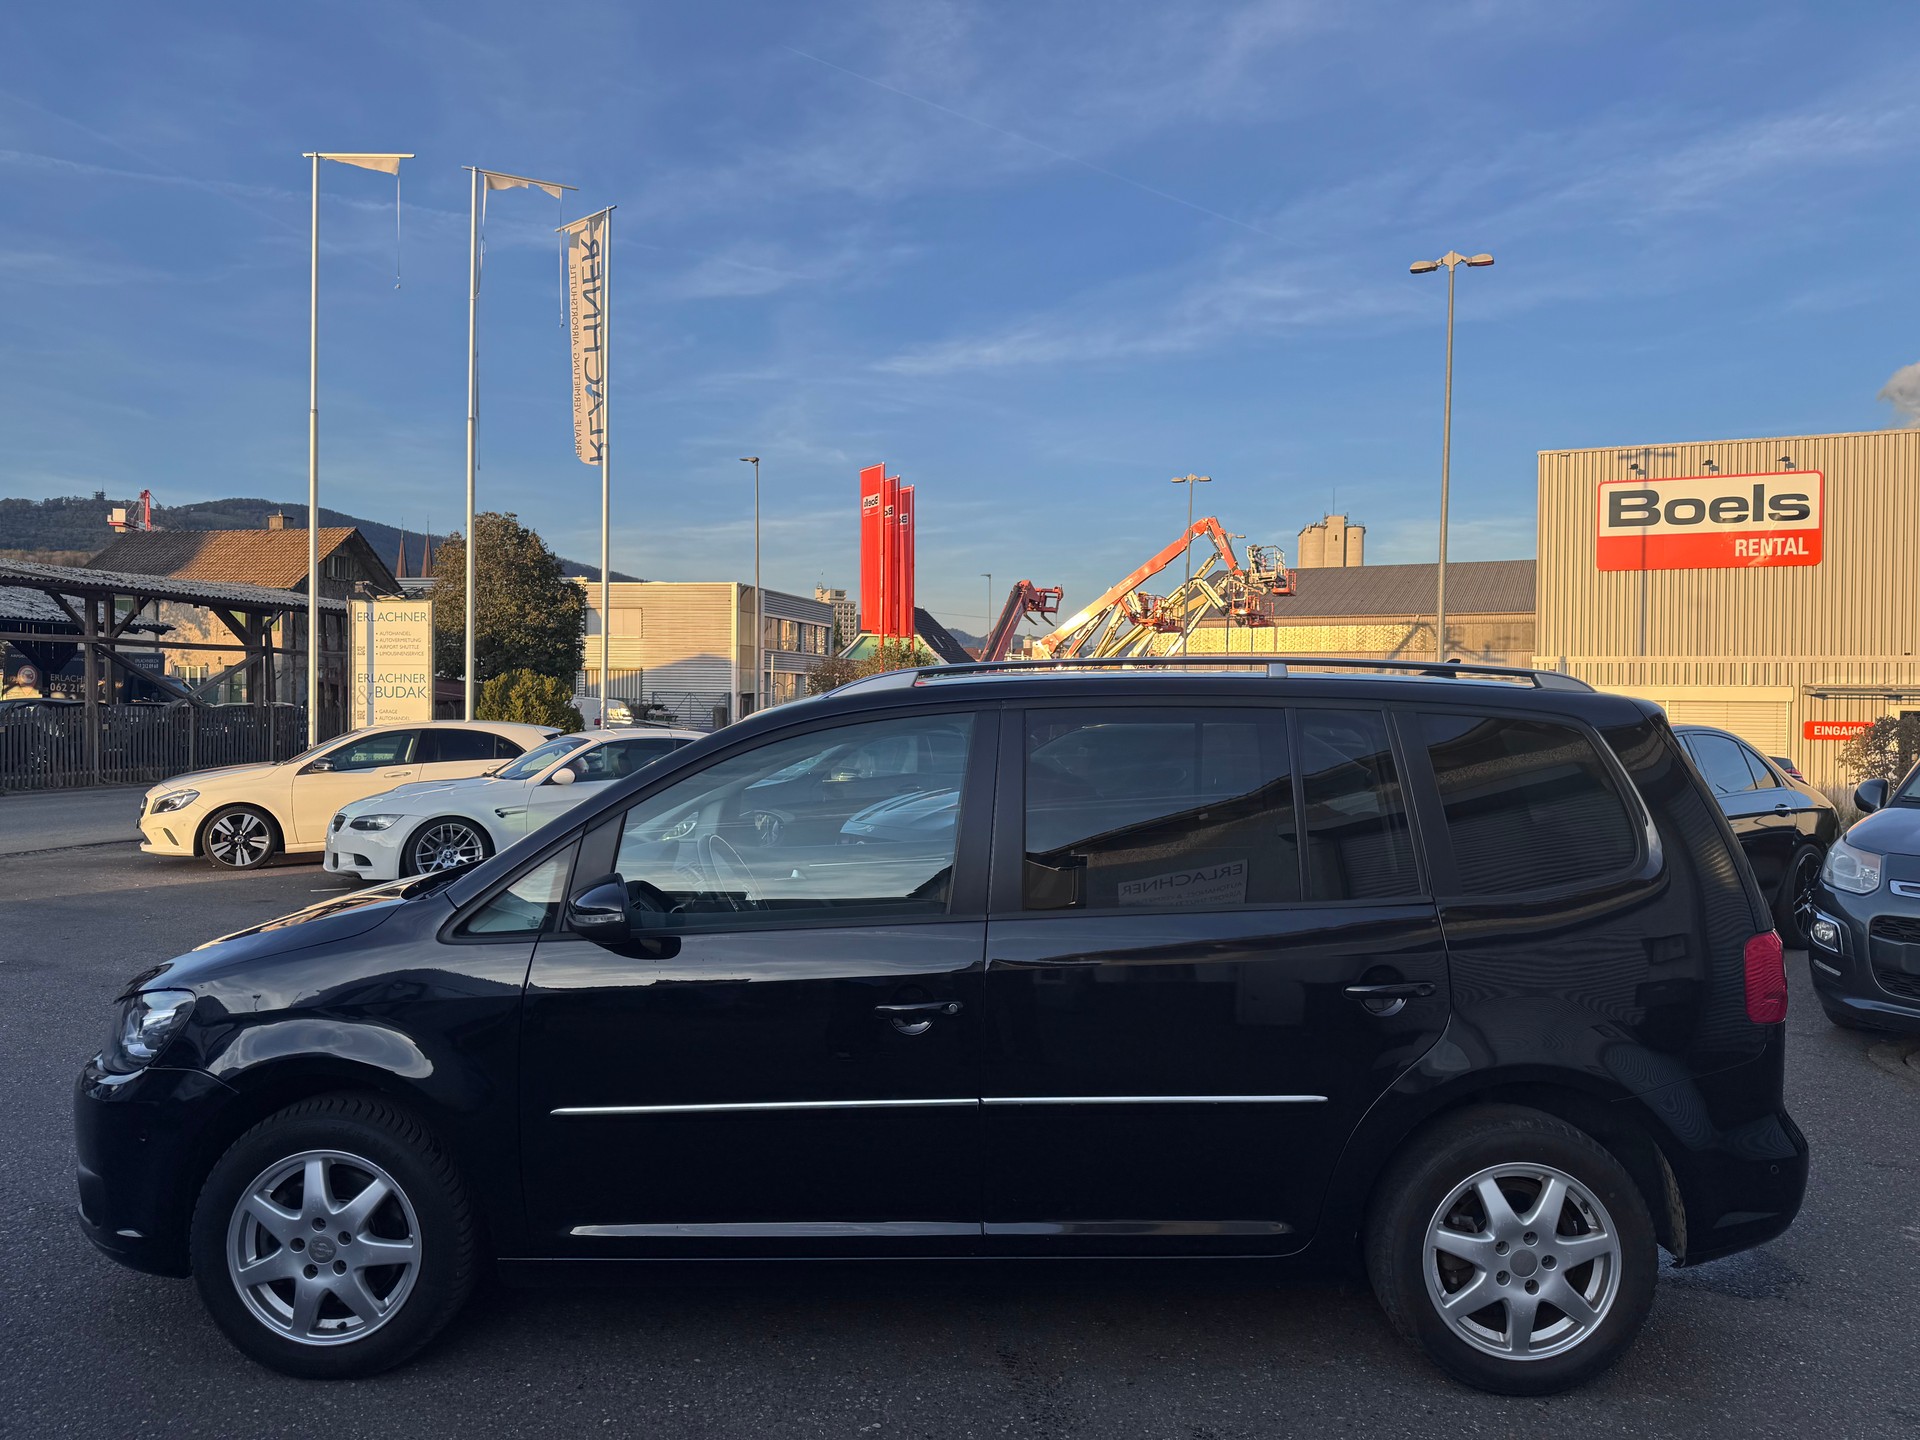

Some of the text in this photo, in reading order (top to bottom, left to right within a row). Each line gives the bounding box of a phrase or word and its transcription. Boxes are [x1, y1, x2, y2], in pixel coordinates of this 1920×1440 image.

[1608, 483, 1811, 528] Boels
[1734, 536, 1809, 557] RENTAL
[357, 612, 427, 622] ERLACHNER
[357, 673, 427, 684] ERLACHNER
[50, 682, 68, 692] 062
[357, 685, 428, 706] & BUDAK
